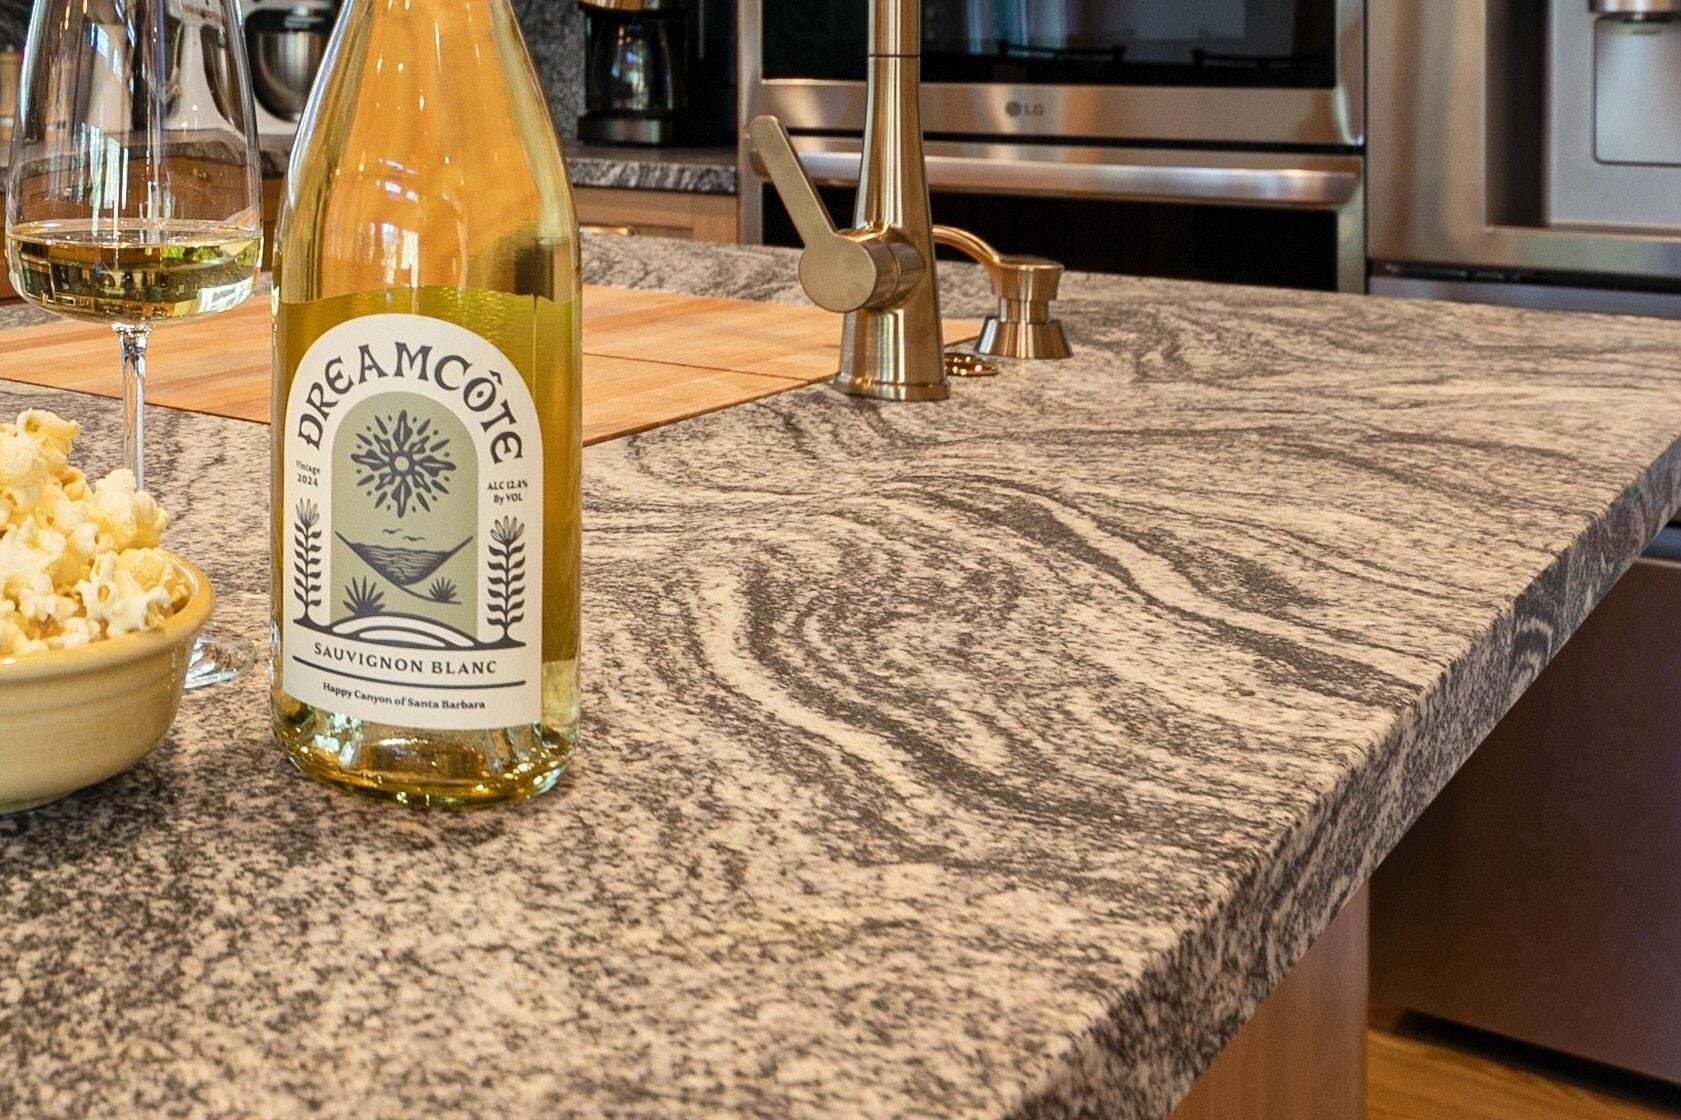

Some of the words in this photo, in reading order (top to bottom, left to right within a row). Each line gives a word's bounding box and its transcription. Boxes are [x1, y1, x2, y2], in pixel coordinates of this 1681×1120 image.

[1024, 101, 1044, 117] LG
[298, 341, 523, 465] DREAMCÔTE
[487, 480, 504, 491] ALC
[505, 492, 523, 503] VOL
[314, 642, 424, 674] SAUVIGNON
[431, 660, 497, 675] BLANC
[322, 681, 352, 699] Happy
[354, 689, 393, 706] Canyon
[394, 696, 405, 706] of
[408, 697, 439, 708] Santa
[441, 700, 486, 709] Barbara
